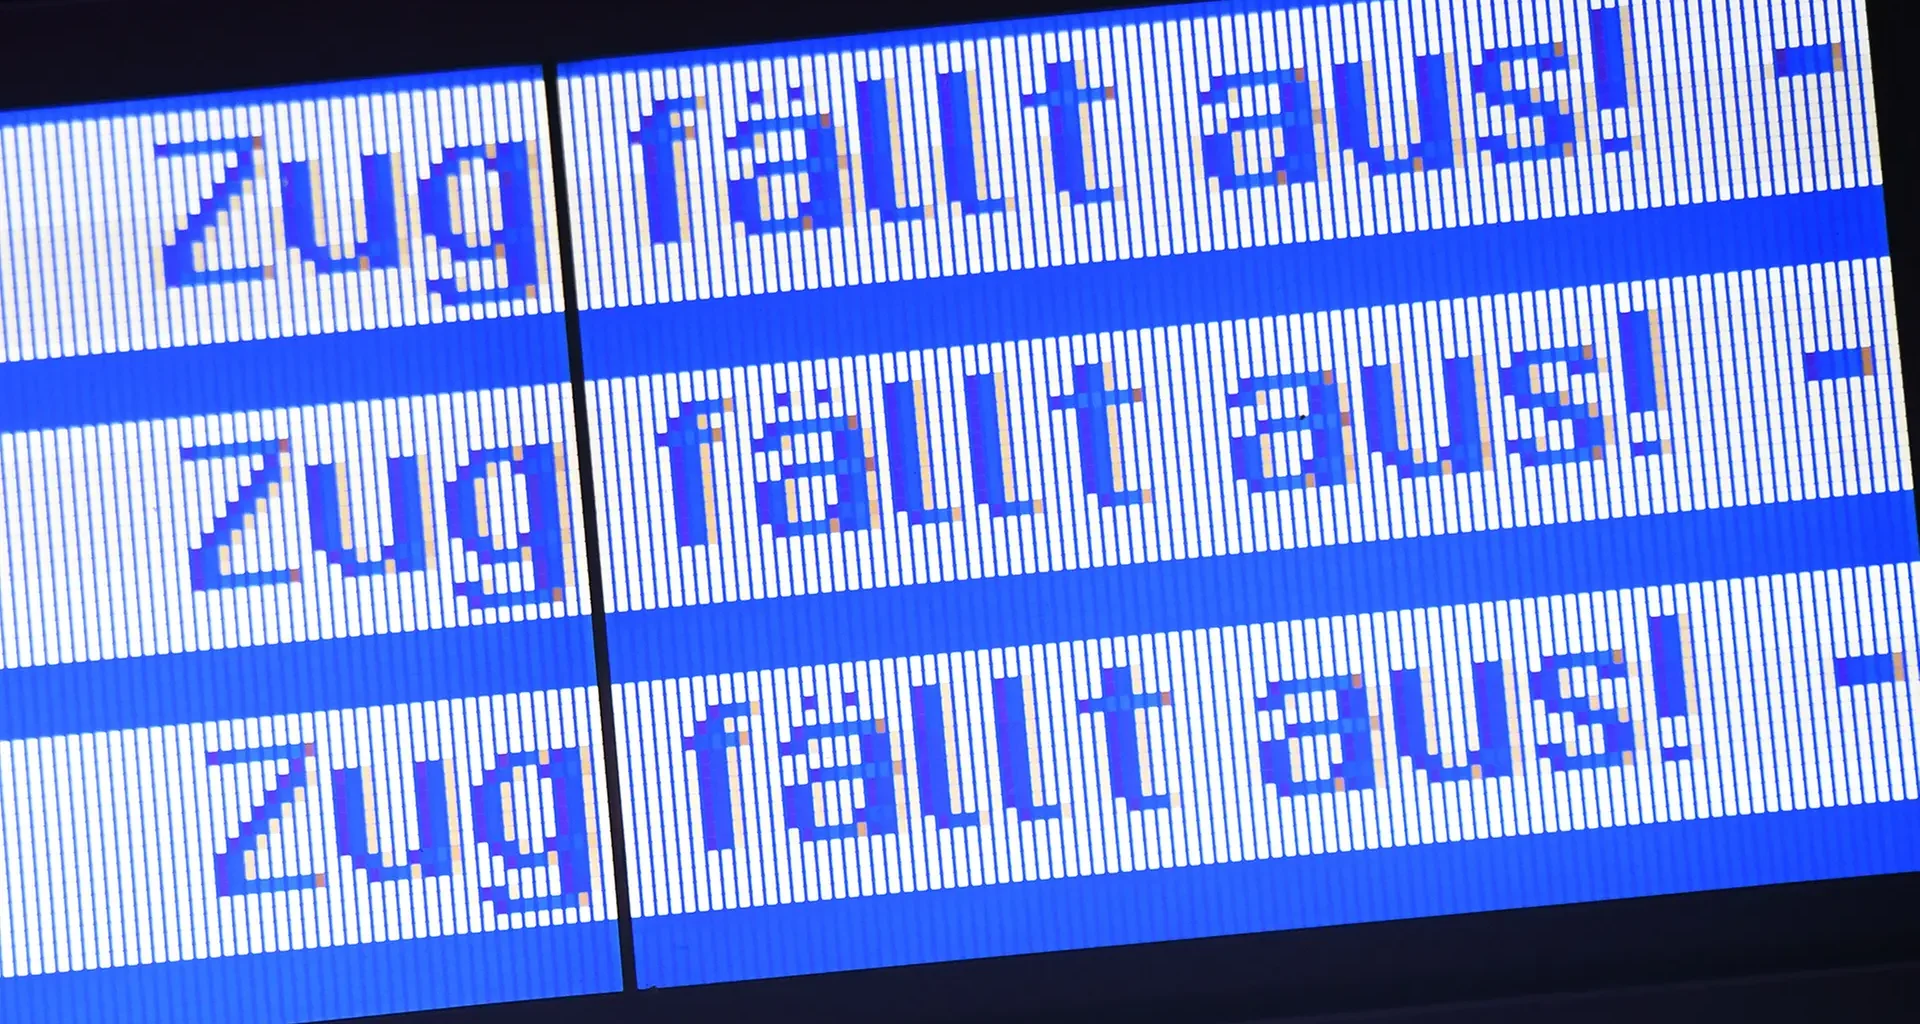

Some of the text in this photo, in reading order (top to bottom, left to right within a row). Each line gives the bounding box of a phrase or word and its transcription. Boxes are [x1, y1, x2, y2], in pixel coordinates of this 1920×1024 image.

[154, 7, 1842, 306] Zug fällt aus! -
[181, 310, 1873, 610] Zug fällt aus! -
[207, 614, 1906, 914] Zug fällt aus! -
